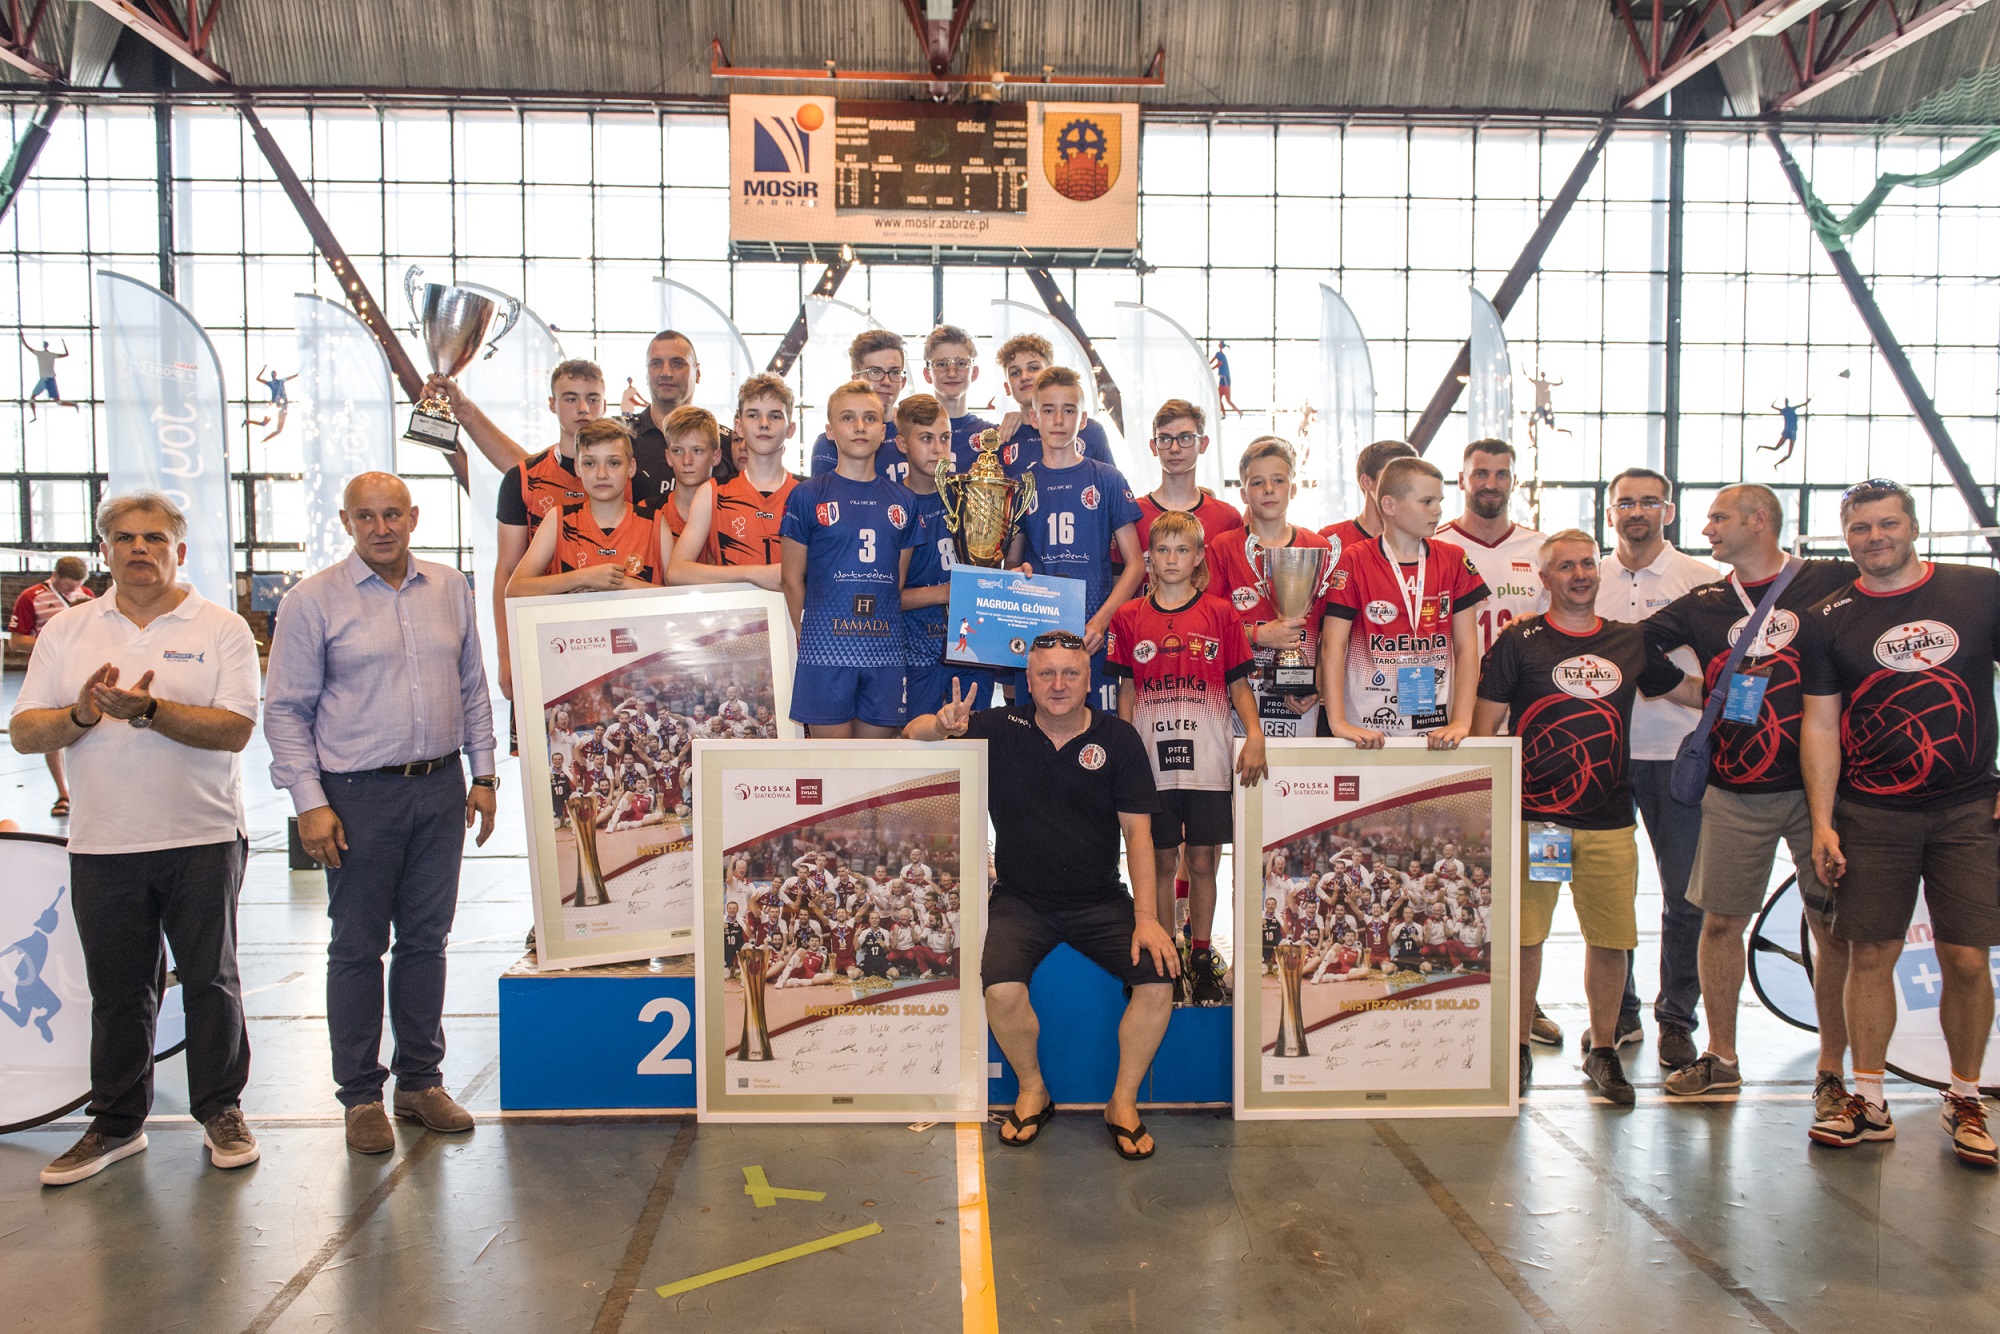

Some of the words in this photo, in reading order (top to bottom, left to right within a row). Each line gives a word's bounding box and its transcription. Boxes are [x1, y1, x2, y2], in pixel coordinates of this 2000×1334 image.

[868, 119, 915, 132] GOSPODARZE
[957, 119, 986, 133] GOŚCIE
[914, 164, 934, 174] CZAS
[935, 164, 952, 175] GRY
[875, 172, 880, 181] 1
[964, 174, 970, 183] 1
[743, 180, 818, 198] MOSiR
[874, 184, 880, 192] 2
[964, 186, 970, 196] 2
[874, 196, 880, 204] 3
[964, 198, 970, 207] 3
[874, 216, 989, 232] www.mosir.zabrze.pl
[1047, 512, 1074, 546] 16
[858, 528, 876, 563] 3
[938, 538, 958, 571] 8
[834, 569, 894, 580] Natrodent
[1406, 576, 1418, 596] 4
[1497, 582, 1526, 599] plus
[857, 599, 874, 612] HT
[976, 598, 1020, 612] NAGRODA
[1022, 603, 1060, 616] GŁÓWNA
[832, 618, 890, 631] TAMADA
[1167, 618, 1173, 630] 2
[1886, 635, 1944, 654] KaEmKa
[1564, 668, 1611, 679] KaEmKa
[1362, 716, 1404, 726] FABRYKA
[1264, 721, 1297, 737] REN
[554, 786, 564, 795] 10
[637, 840, 693, 856] MISTRZO
[727, 936, 736, 945] 10
[1265, 932, 1274, 941] 10
[870, 946, 879, 955] 17
[1404, 941, 1412, 949] 17
[804, 1004, 900, 1017] MISTRZOWSKI
[903, 1004, 949, 1016] SKŁAD
[1339, 1000, 1432, 1011] MISTRZOWSKI
[1435, 998, 1480, 1011] SKŁAD
[636, 996, 692, 1074] 2
